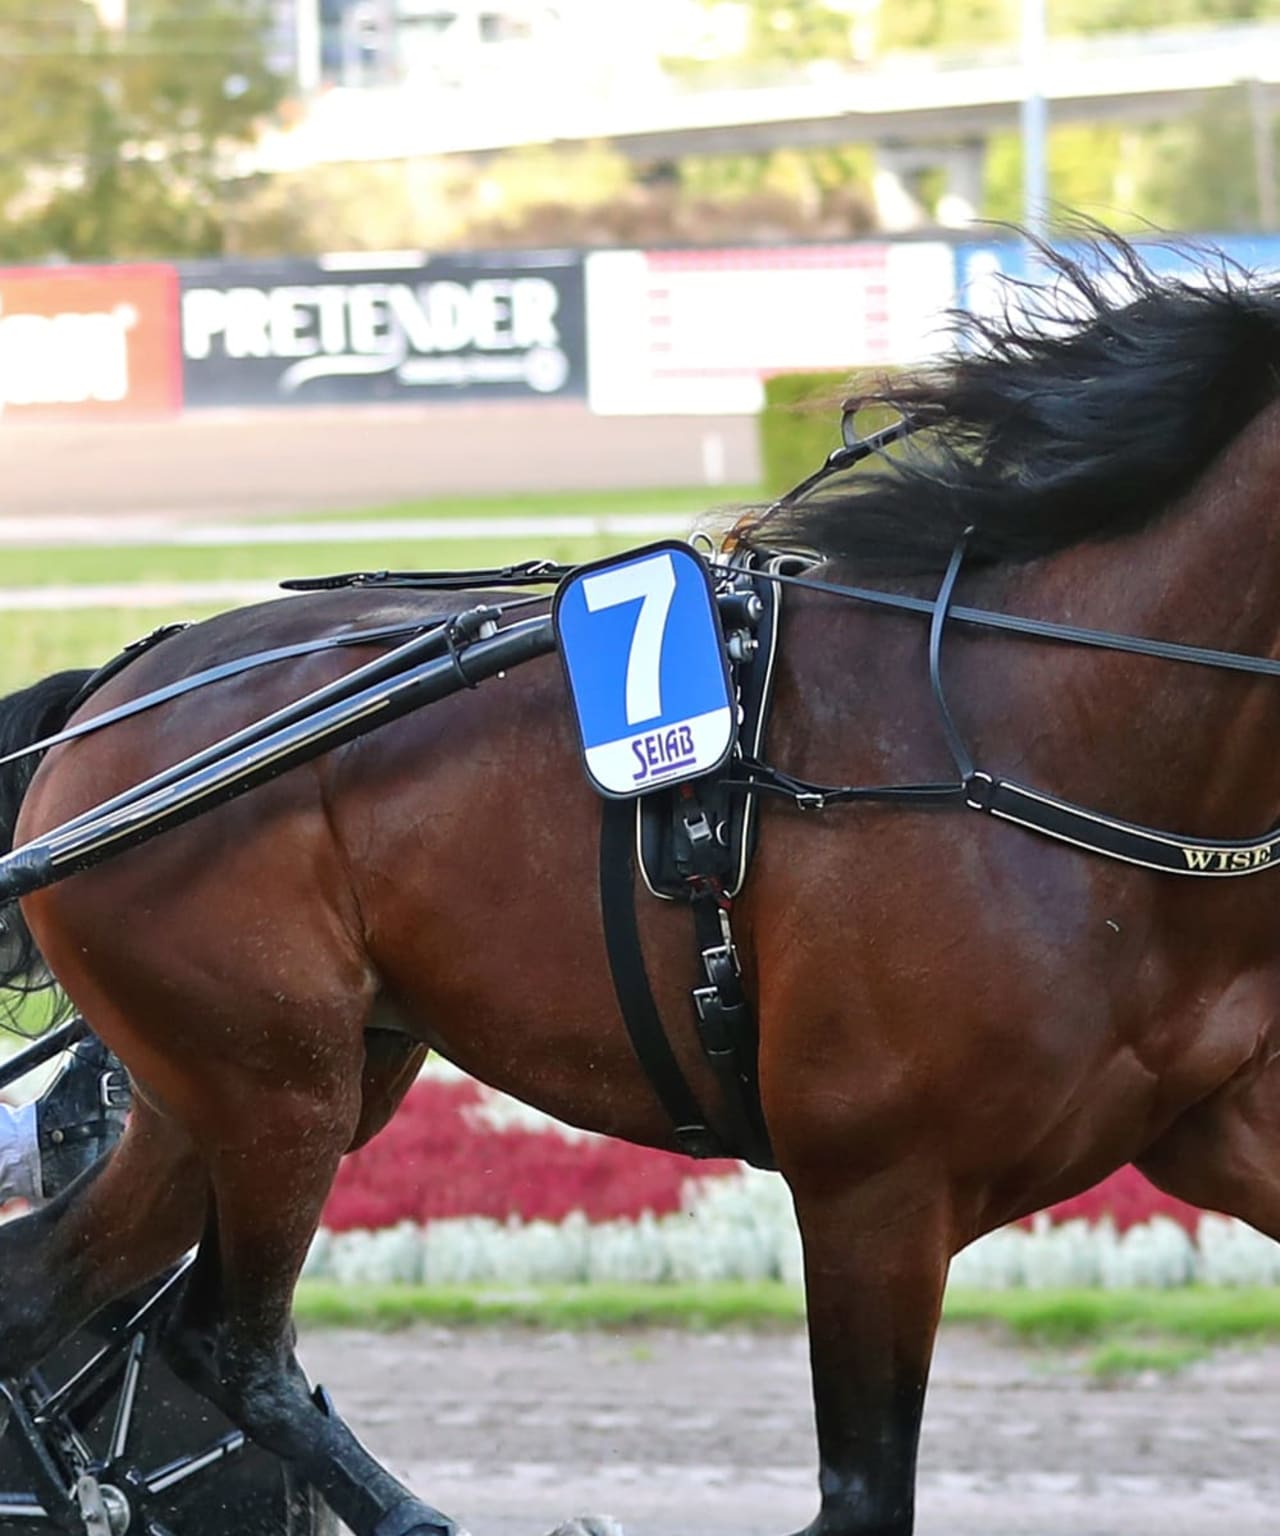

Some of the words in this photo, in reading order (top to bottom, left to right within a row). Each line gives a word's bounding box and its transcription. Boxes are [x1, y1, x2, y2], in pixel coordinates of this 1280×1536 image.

[182, 278, 558, 359] PRETENDER
[582, 554, 677, 726] 7
[632, 725, 694, 780] SEIAB
[1182, 847, 1270, 871] WISE
